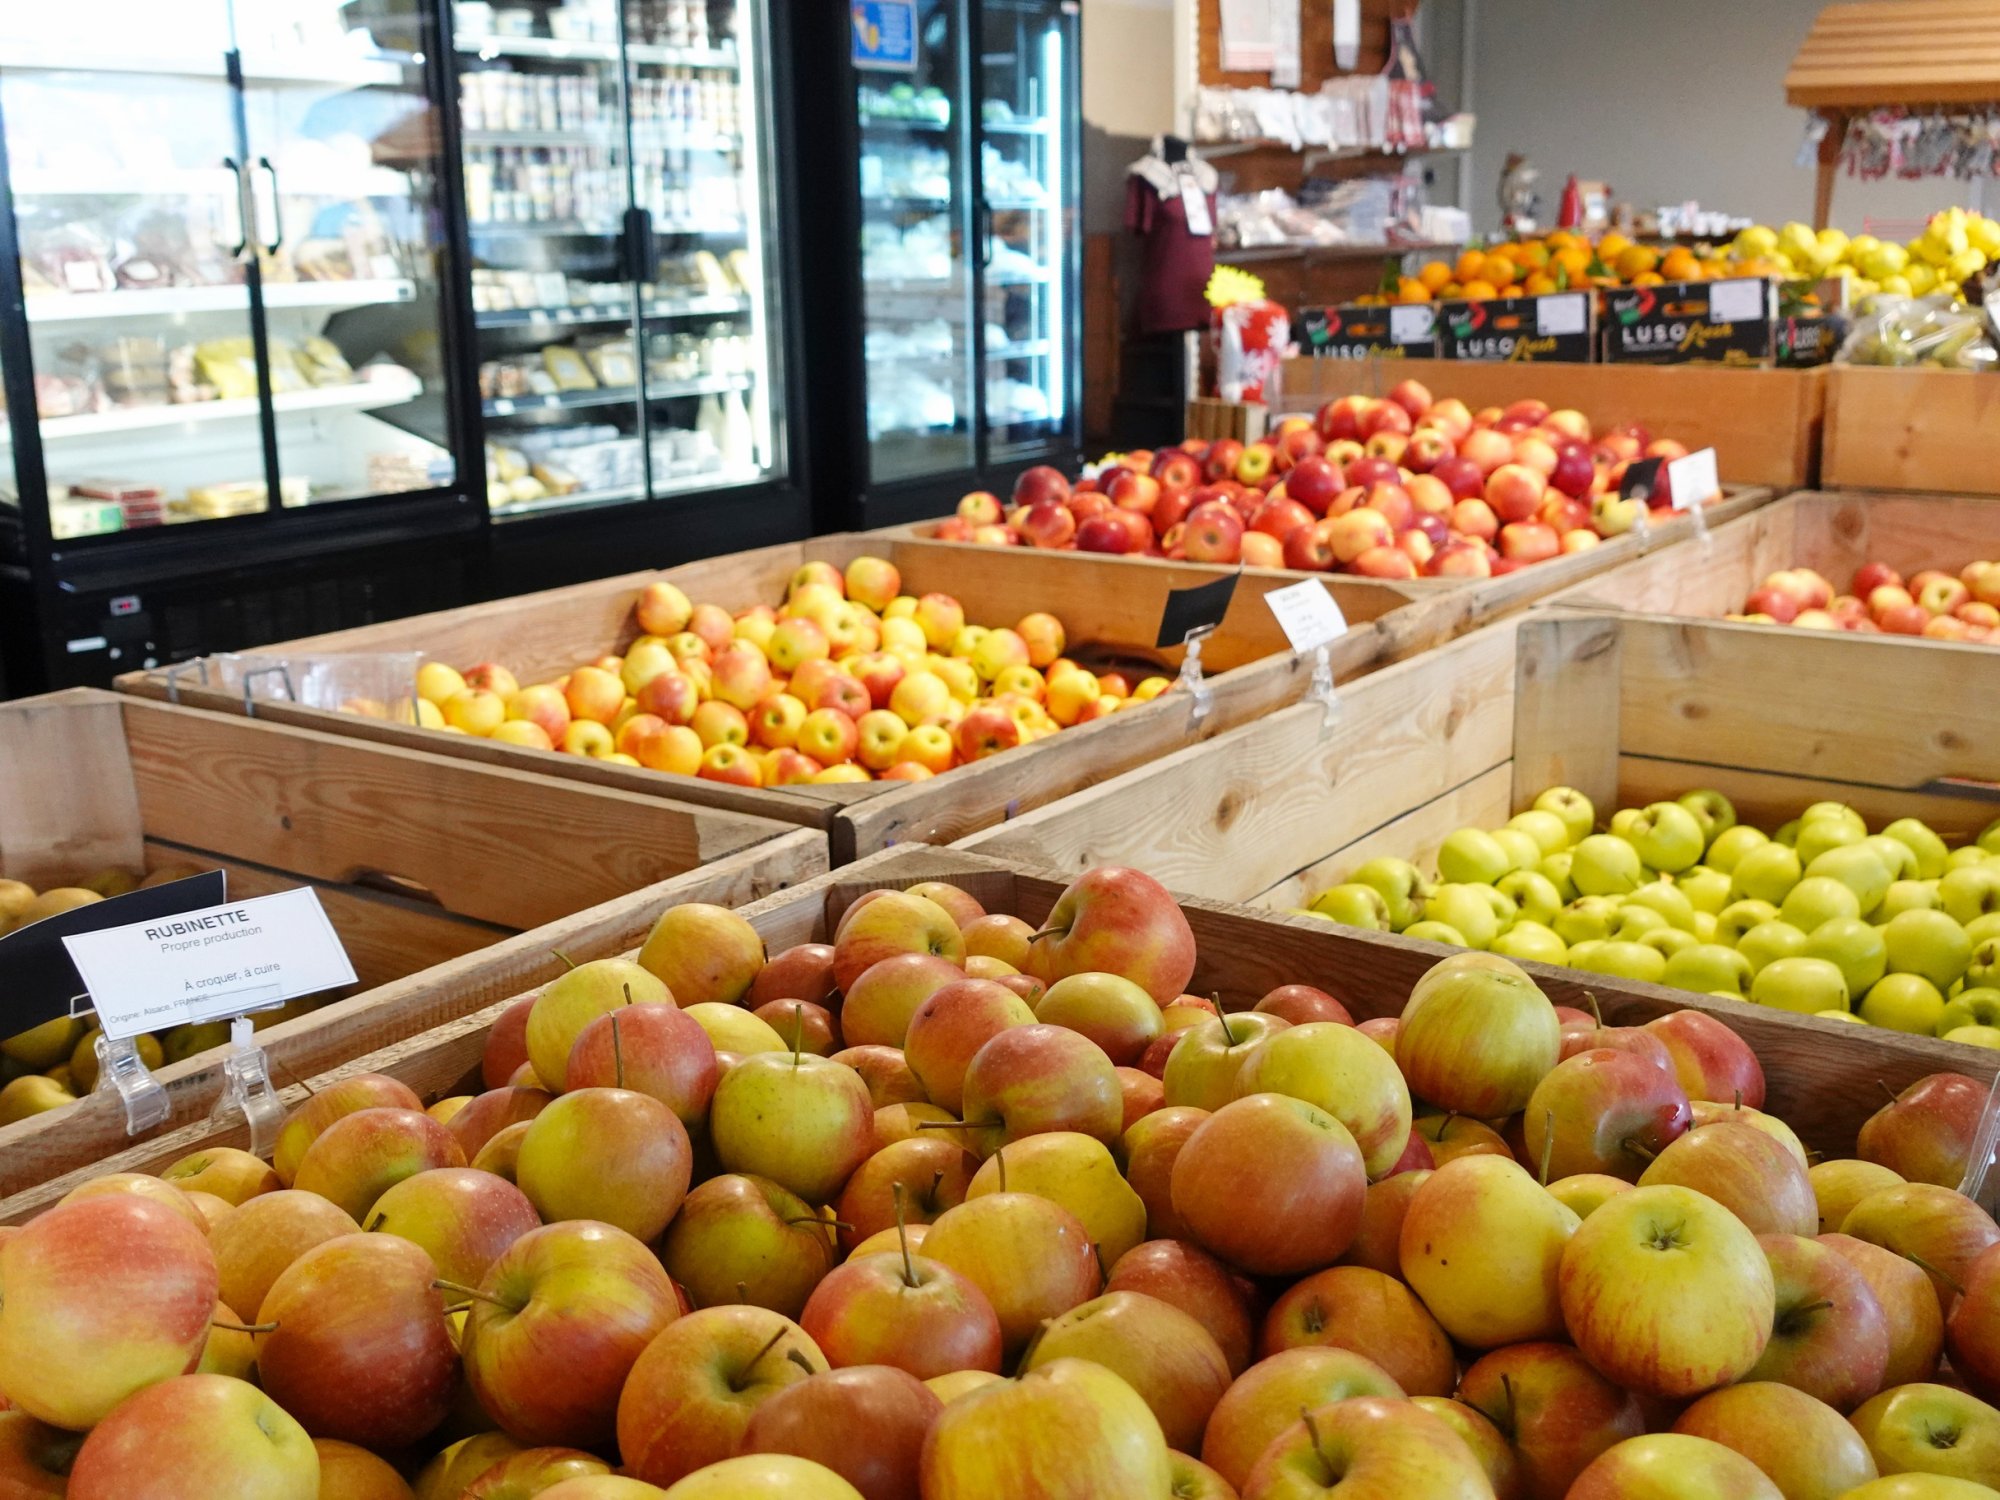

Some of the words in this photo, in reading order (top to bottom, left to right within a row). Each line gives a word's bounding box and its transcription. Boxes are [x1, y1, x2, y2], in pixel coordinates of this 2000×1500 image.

[1622, 322, 1687, 344] LUSO
[1456, 336, 1515, 358] LUSO
[145, 909, 250, 941] RUBINETTE
[161, 939, 201, 953] Propre
[204, 926, 262, 946] production
[196, 970, 243, 987] croquer,
[244, 967, 252, 978] à
[253, 962, 281, 976] cuire
[109, 1010, 141, 1024] Origine:
[173, 994, 211, 1007] FRANCE
